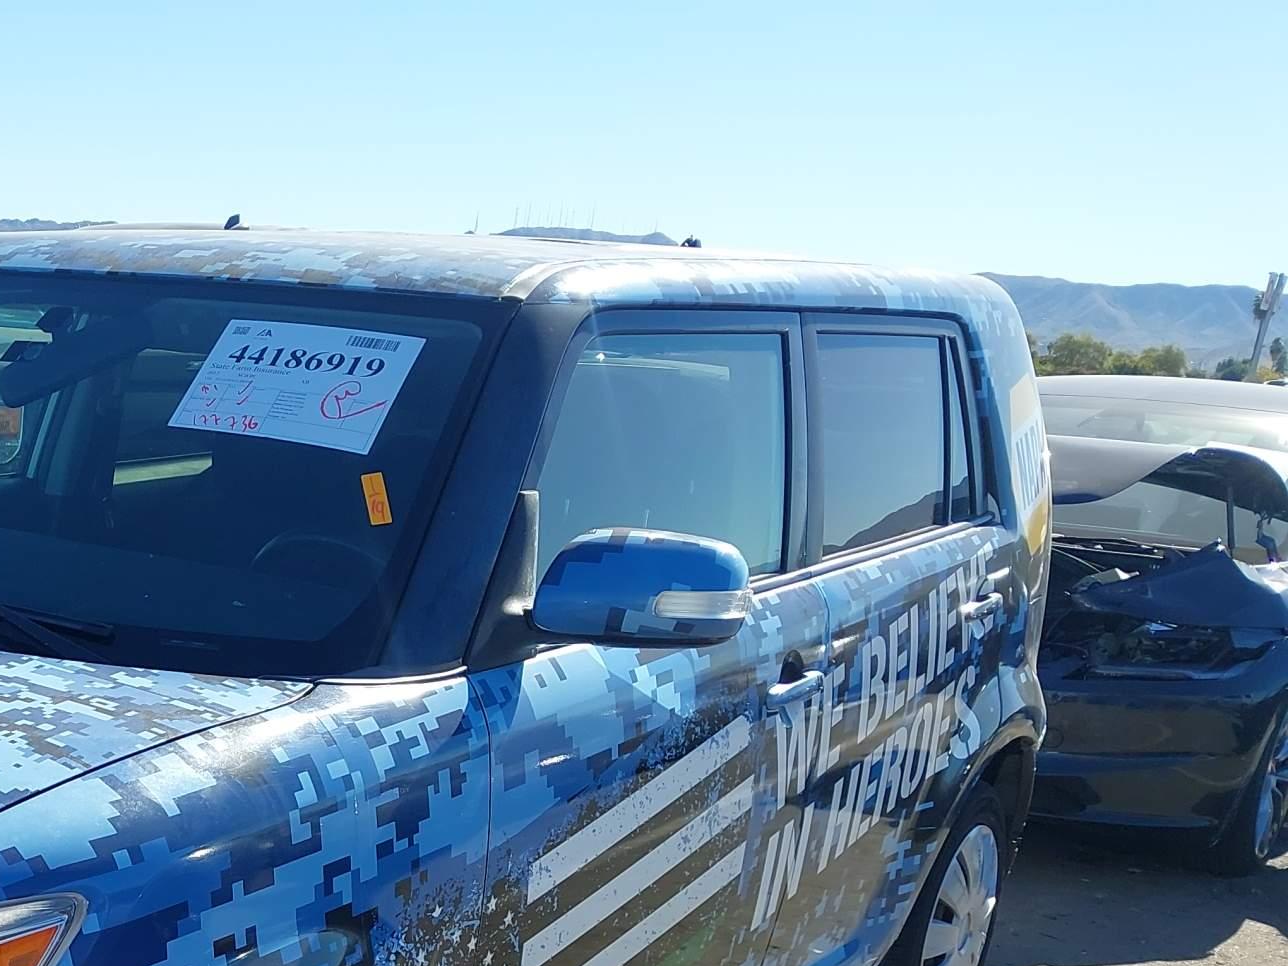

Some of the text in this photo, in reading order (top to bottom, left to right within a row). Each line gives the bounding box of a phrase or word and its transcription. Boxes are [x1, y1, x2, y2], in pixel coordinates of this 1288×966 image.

[211, 362, 229, 370] State
[252, 366, 291, 376] Insurance
[228, 344, 386, 378] 44186919
[776, 540, 996, 810] WE BELIEVE
[750, 667, 981, 932] IN HEROES
